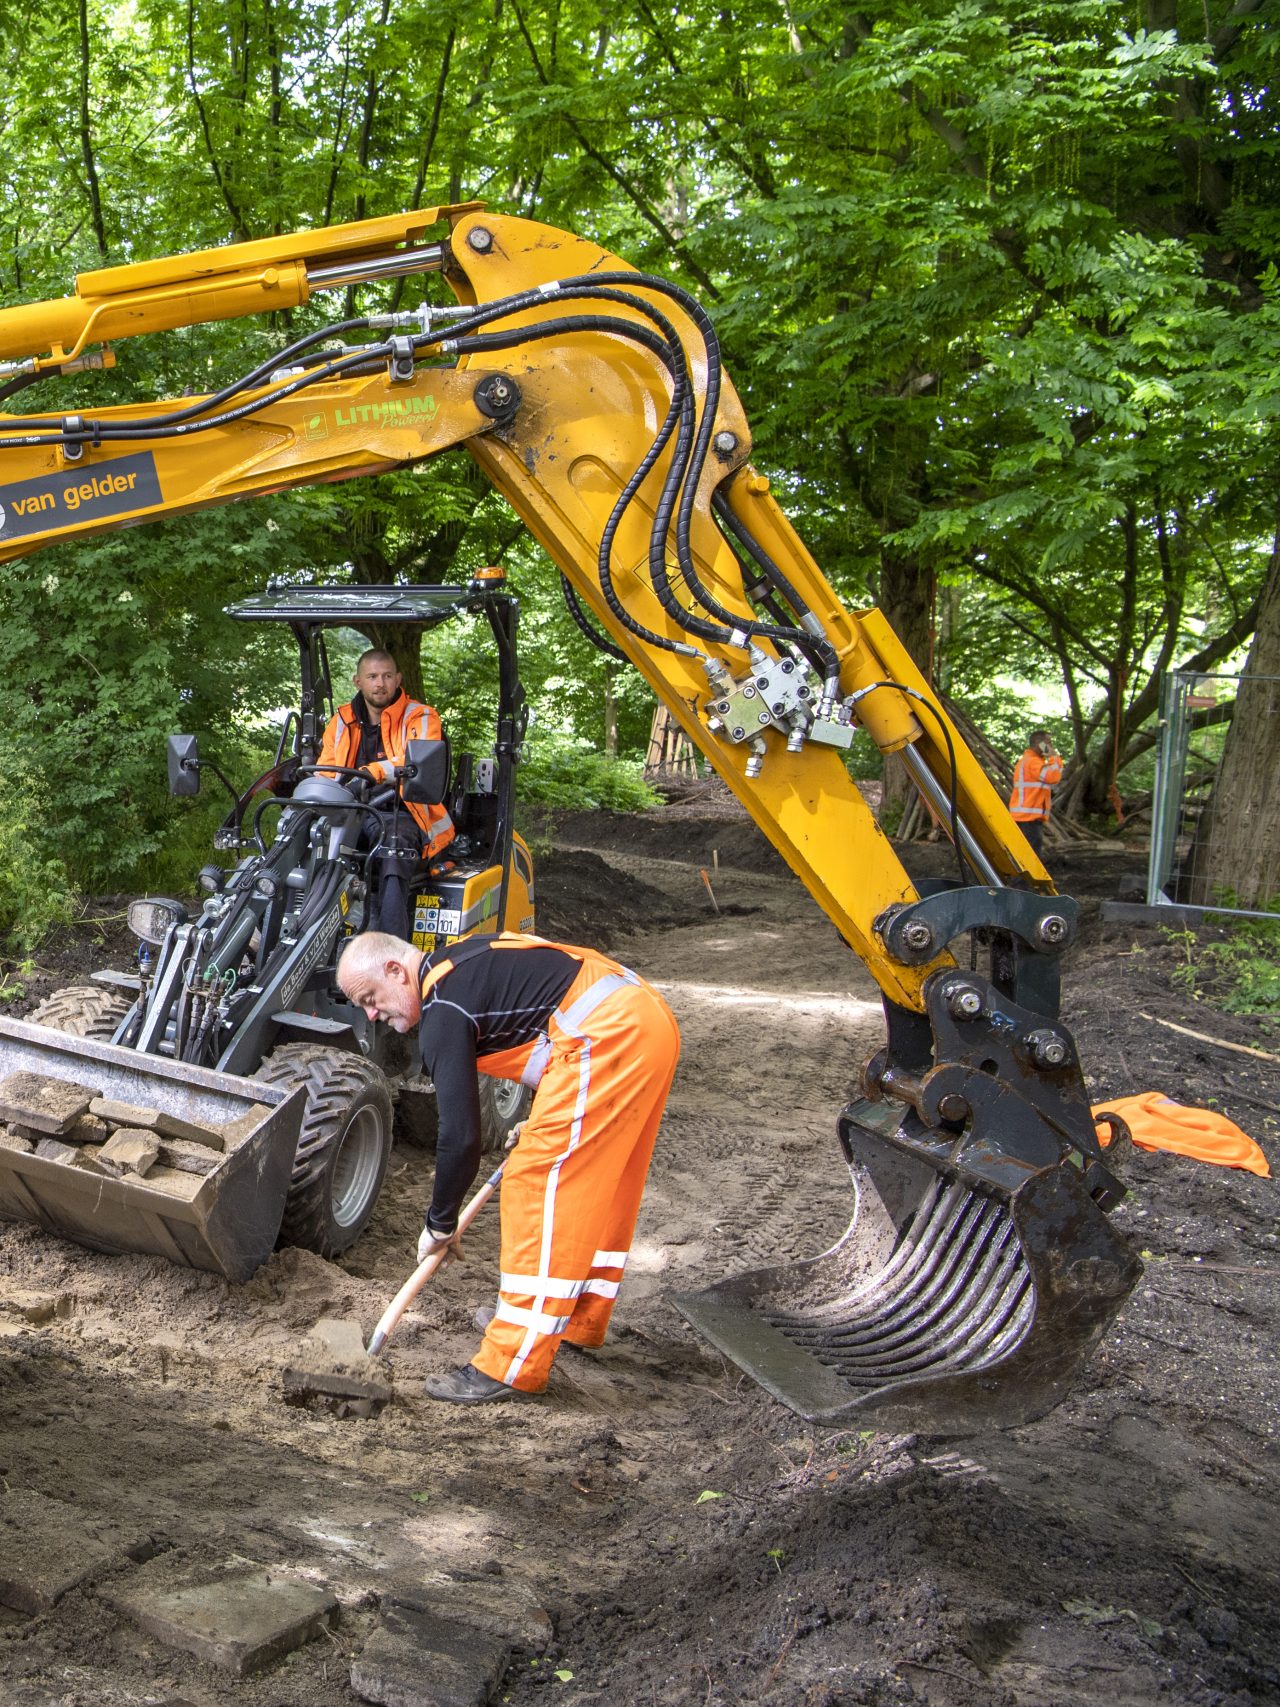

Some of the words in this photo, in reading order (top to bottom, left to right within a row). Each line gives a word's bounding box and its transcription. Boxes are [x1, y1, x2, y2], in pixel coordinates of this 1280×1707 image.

[335, 395, 436, 426] LITHIUM
[381, 403, 440, 429] Powered
[11, 492, 56, 516] van
[63, 472, 137, 510] gelder
[439, 919, 453, 933] 101
